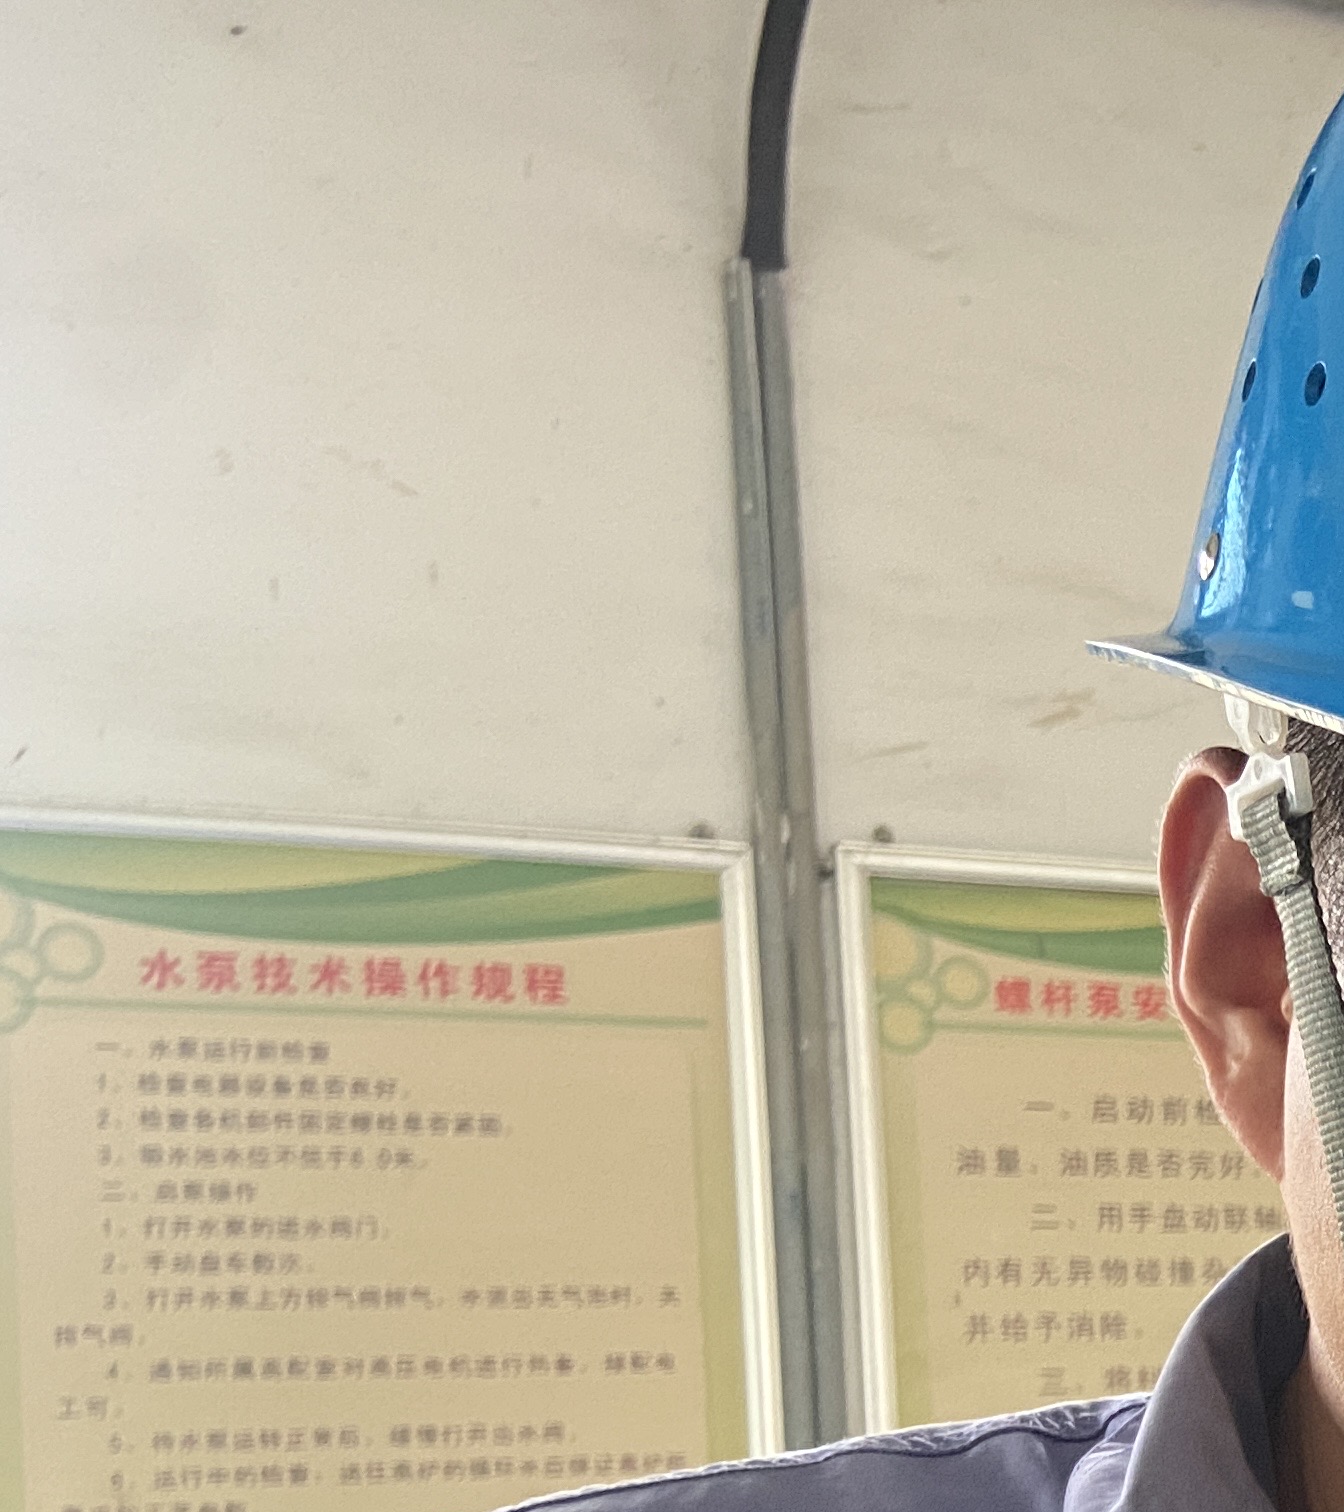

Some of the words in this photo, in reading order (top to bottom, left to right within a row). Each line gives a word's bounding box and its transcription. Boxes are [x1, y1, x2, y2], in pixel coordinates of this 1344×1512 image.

[141, 948, 571, 1006] 水泵技术操作规程
[995, 977, 1168, 1022] 螺杆泵安
